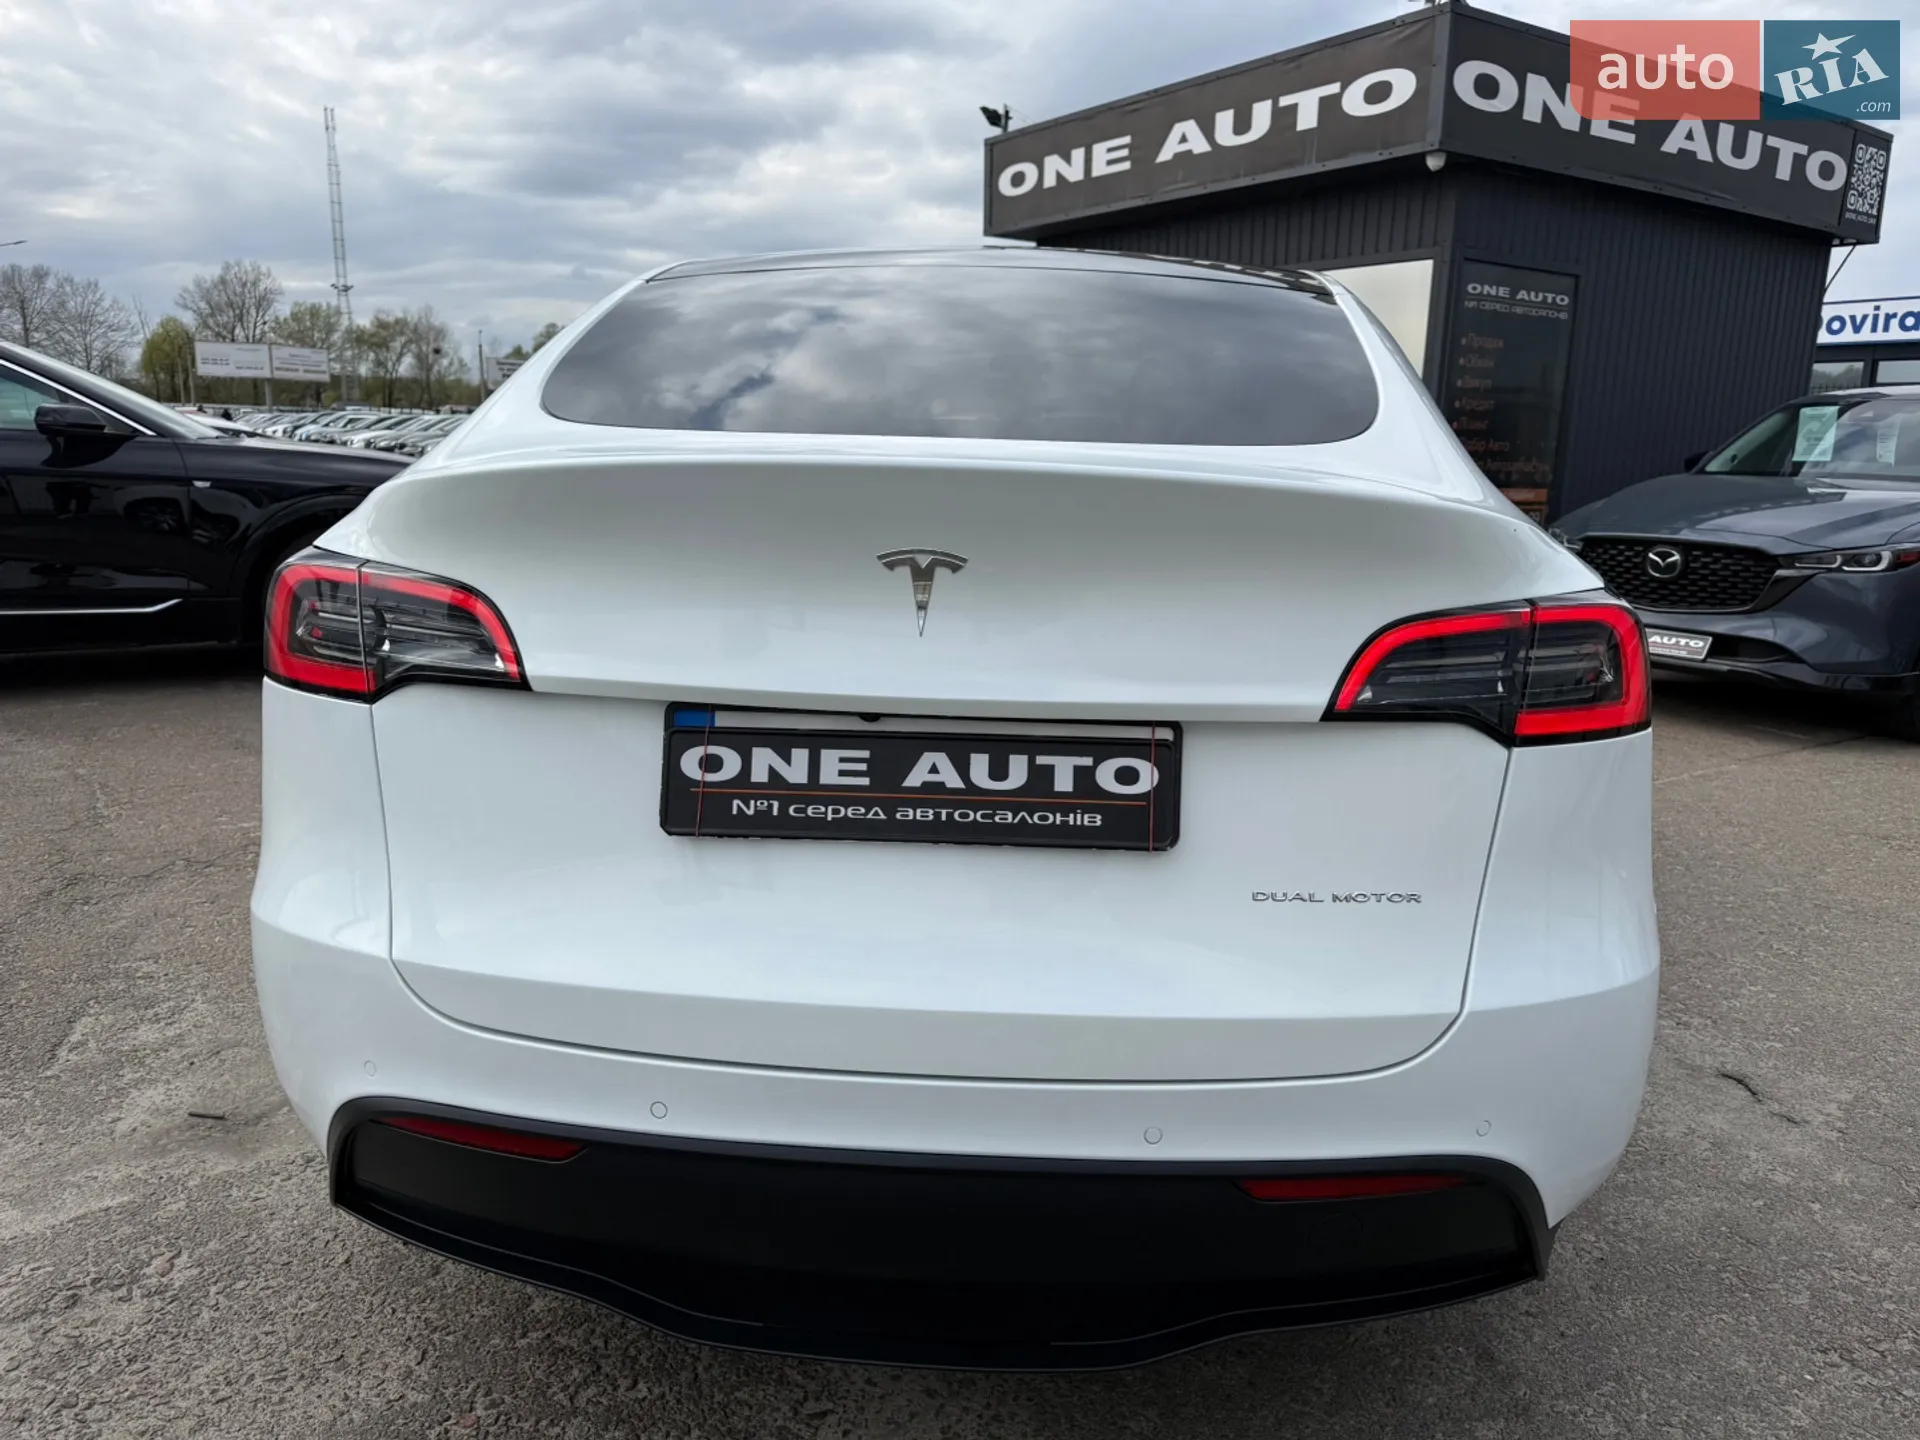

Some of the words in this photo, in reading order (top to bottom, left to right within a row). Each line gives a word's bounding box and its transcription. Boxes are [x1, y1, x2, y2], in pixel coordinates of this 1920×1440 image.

[998, 134, 1132, 197] ONE
[1155, 67, 1417, 164] AUTO
[1453, 60, 1641, 145] ONE
[1660, 112, 1847, 191] AUTO
[1466, 283, 1511, 298] ONE
[1515, 289, 1570, 306] AUTO
[1824, 305, 1920, 336] ovira
[1648, 634, 1704, 648] AUTO
[680, 745, 871, 786] ONE
[901, 751, 1160, 795] AUTO
[732, 799, 779, 816] №1
[788, 804, 887, 821] серед
[895, 807, 1102, 827] автосалонів
[1251, 891, 1324, 902] DUAL
[1331, 892, 1422, 903] MOTOR
